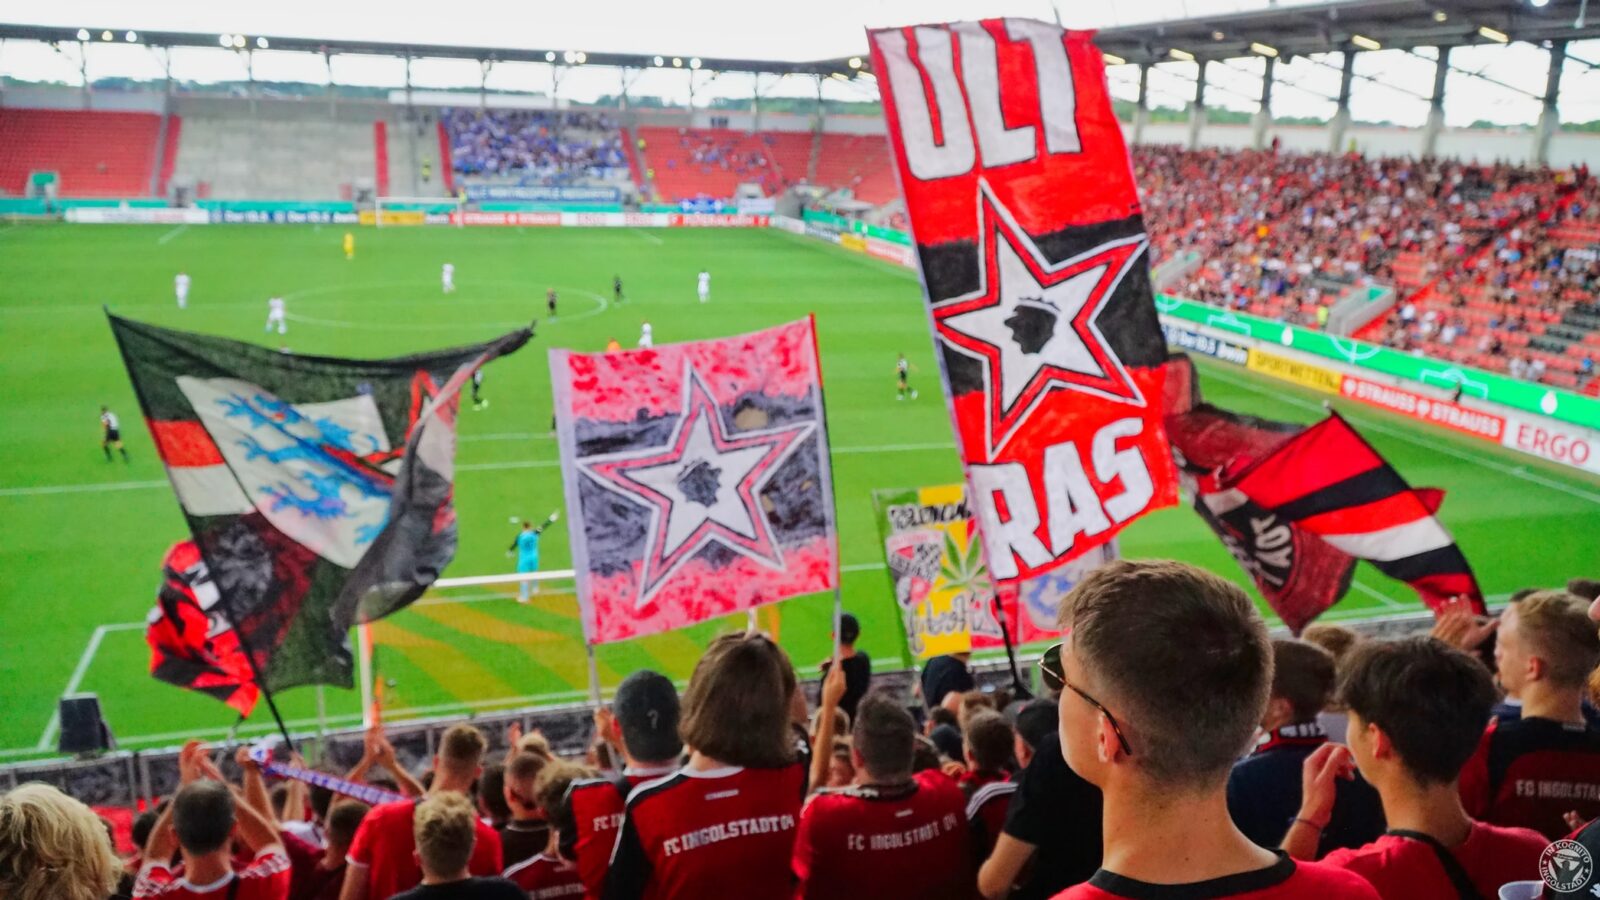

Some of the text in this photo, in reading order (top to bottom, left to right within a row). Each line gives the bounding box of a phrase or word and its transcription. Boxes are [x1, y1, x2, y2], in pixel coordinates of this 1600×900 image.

[872, 17, 1082, 180] ULT
[1257, 352, 1334, 389] SPORTWETTEN
[1357, 381, 1416, 413] STRAUSS
[1431, 402, 1501, 437] STRAUSS
[1517, 423, 1591, 465] ERGO
[969, 416, 1154, 580] RAS
[1516, 780, 1535, 797] FC
[593, 815, 609, 832] FC
[663, 837, 681, 857] FC
[681, 815, 780, 851] INGOLSTADT
[847, 834, 865, 851] FC
[870, 821, 940, 851] INGOLSTADT
